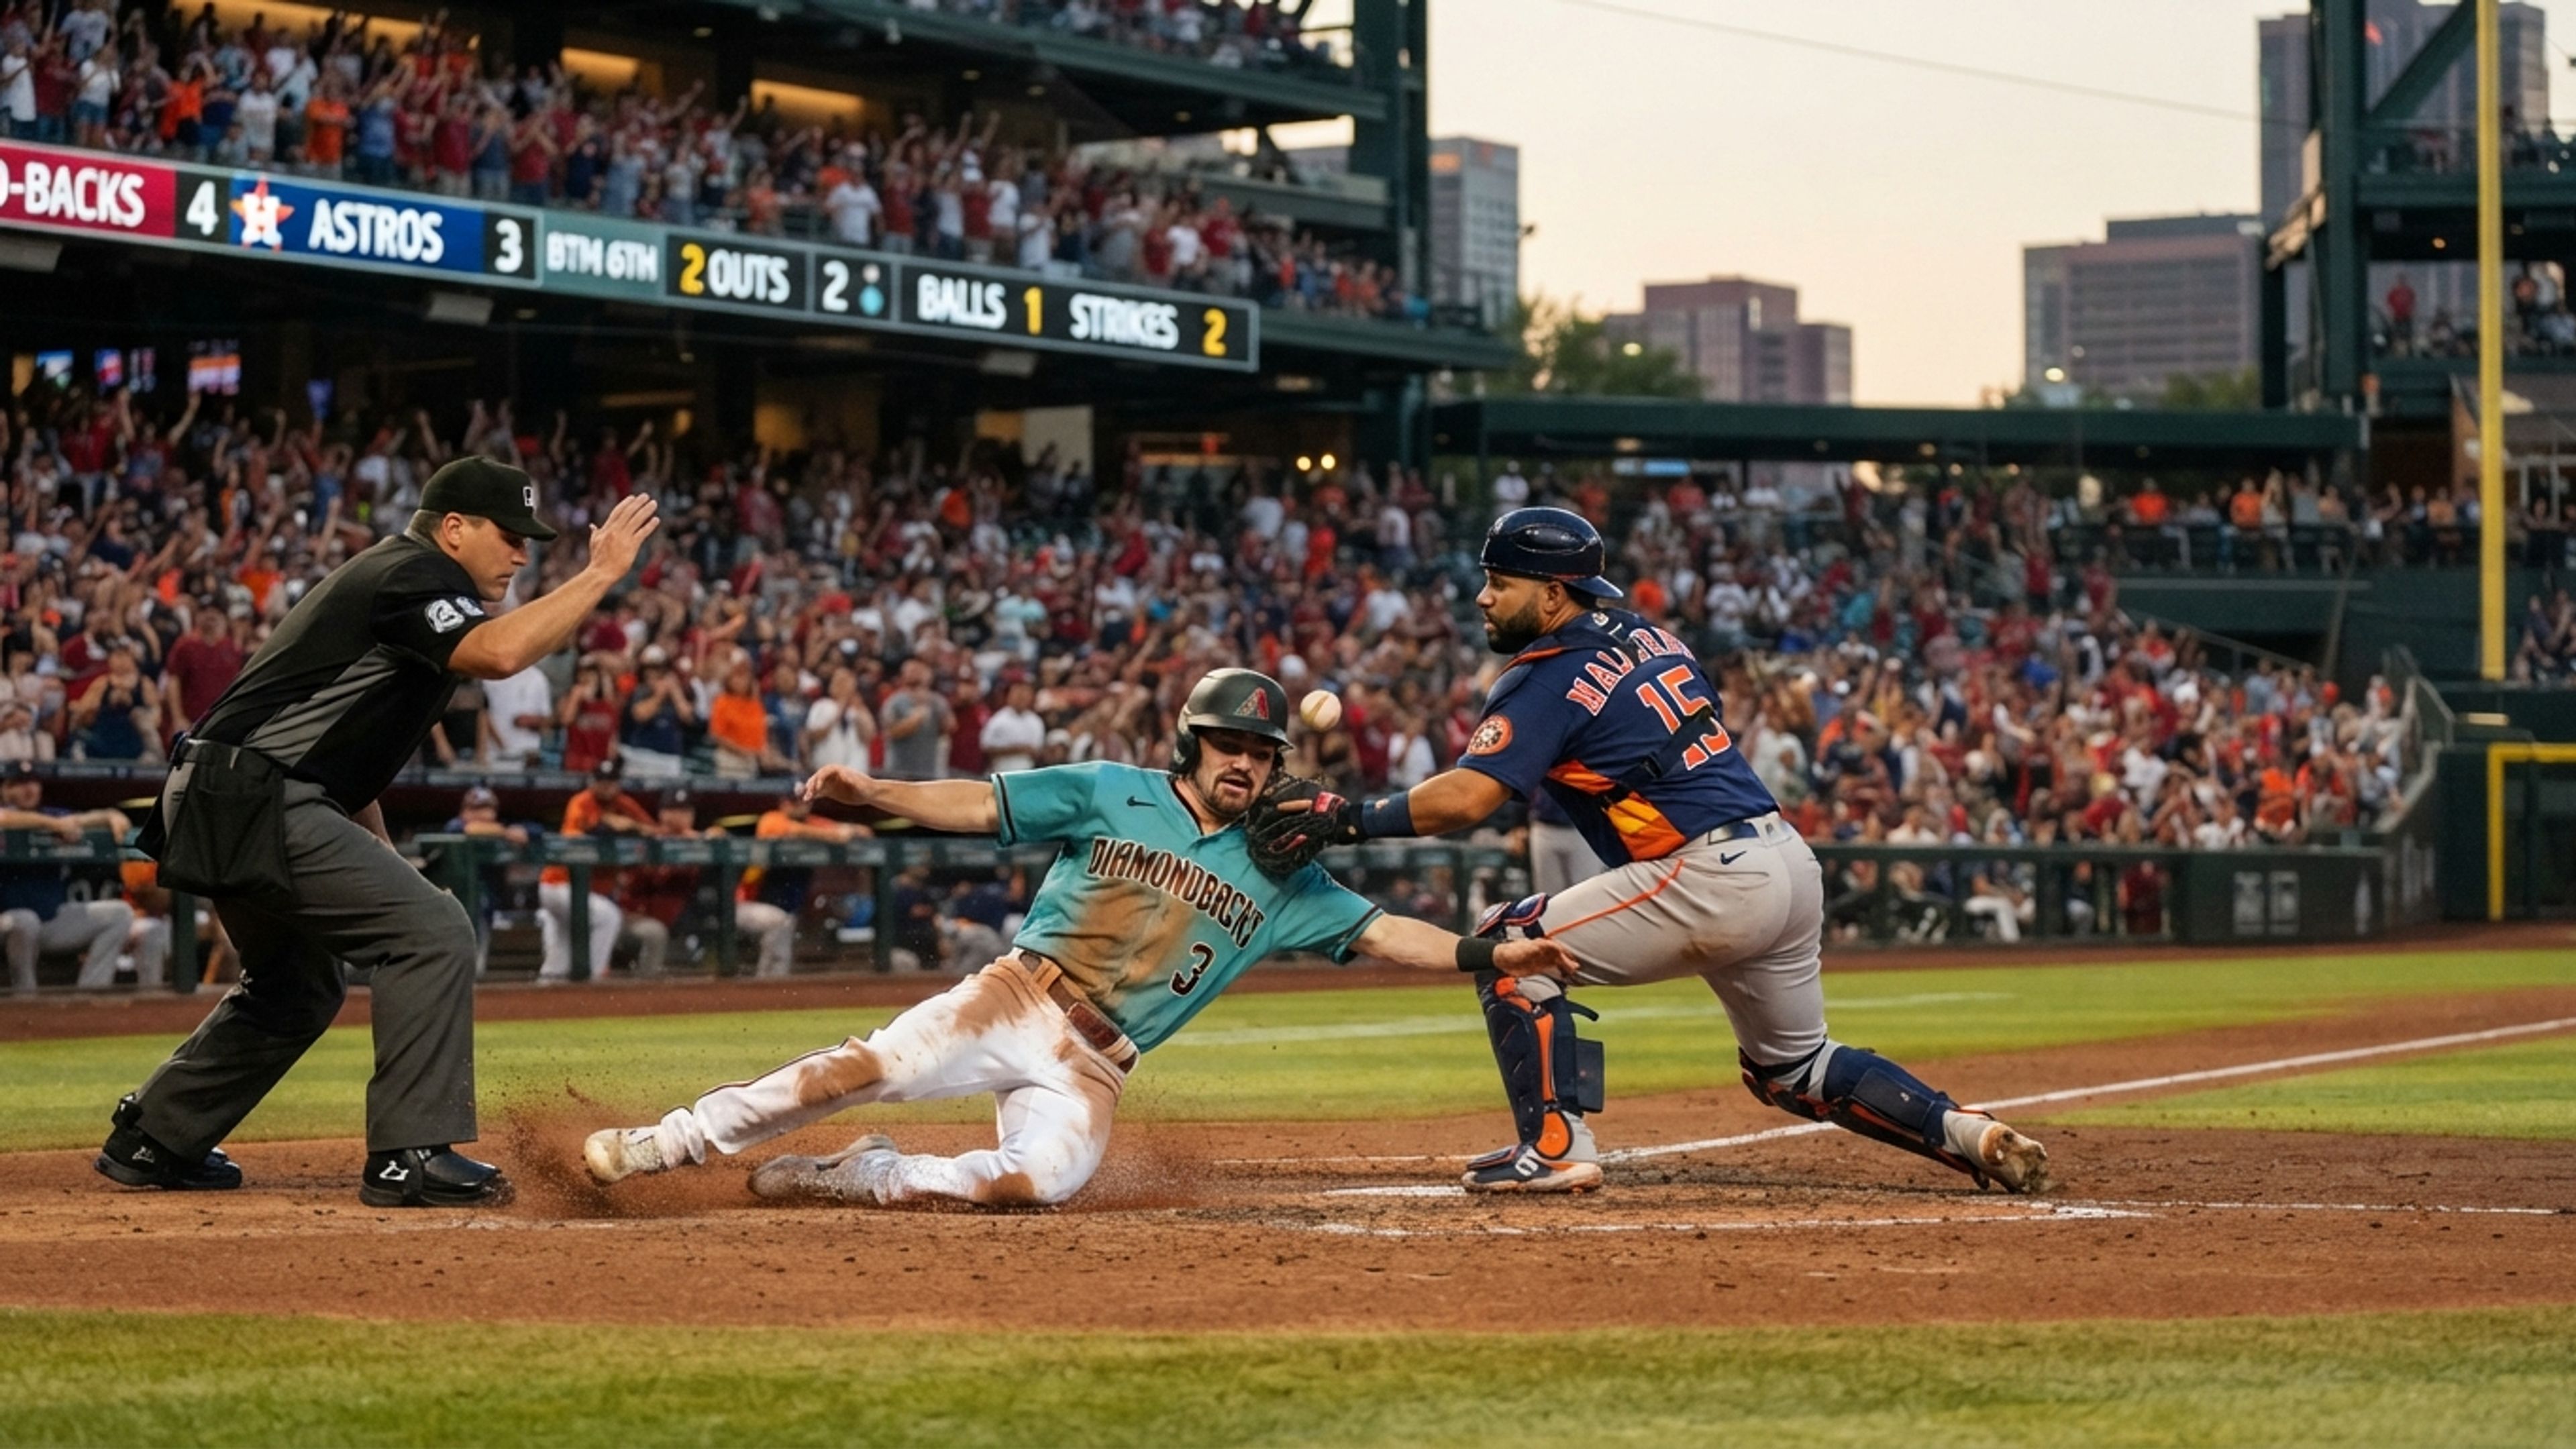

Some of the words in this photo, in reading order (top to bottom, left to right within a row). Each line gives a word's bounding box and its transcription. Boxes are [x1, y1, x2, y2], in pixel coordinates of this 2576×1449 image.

[186, 180, 219, 235] 4
[308, 199, 444, 263] ASTROS
[494, 219, 523, 273] 3
[547, 231, 603, 276] BTM
[606, 239, 658, 282] 6TH
[680, 243, 705, 295] 2
[708, 249, 790, 303] OUTS
[822, 260, 849, 312] 2
[917, 274, 1007, 329] BALLS
[1023, 286, 1043, 335] 1
[1070, 292, 1179, 350] STRIKES
[1202, 309, 1227, 356] 2
[1170, 942, 1215, 996] 3
